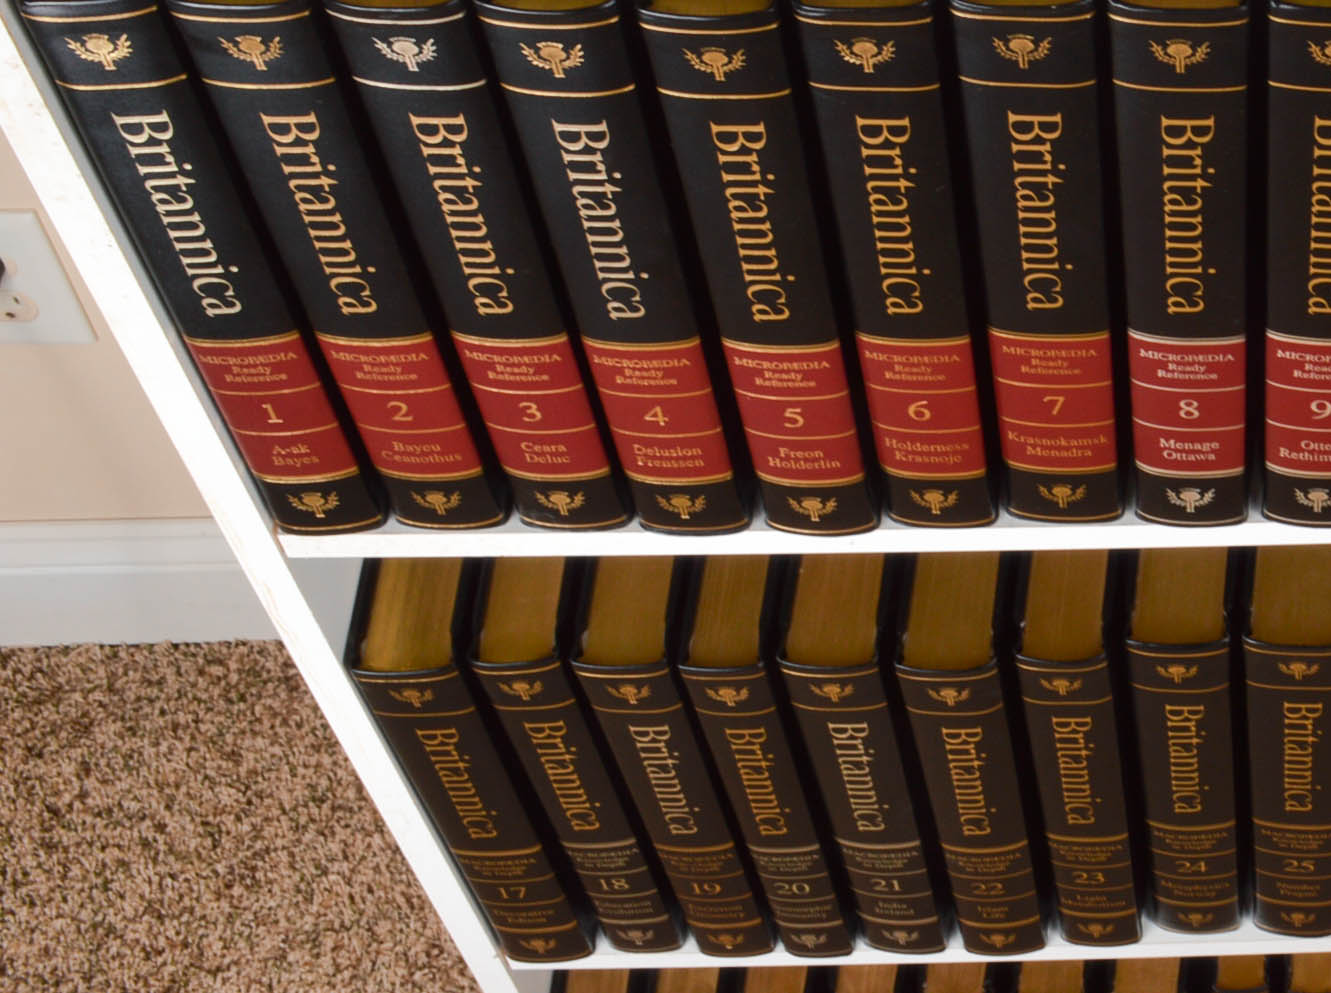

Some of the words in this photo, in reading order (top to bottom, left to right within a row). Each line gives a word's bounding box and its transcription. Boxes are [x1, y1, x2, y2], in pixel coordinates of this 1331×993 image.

[110, 109, 243, 318] Britannica
[258, 111, 378, 317] Britannica
[408, 111, 516, 317] Britannica
[855, 113, 932, 316] Britannica
[1007, 110, 1074, 311] Britannica
[1160, 114, 1216, 316] Britannica
[551, 117, 649, 321] Britannica
[709, 120, 796, 323] Britannica
[363, 364, 402, 374] Ready
[496, 365, 535, 374] Ready
[894, 364, 932, 374] Ready
[1031, 358, 1068, 368] Ready
[1168, 362, 1207, 373] Ready
[231, 366, 271, 374] Ready
[356, 371, 418, 381] Reference
[487, 371, 549, 382] Reference
[624, 369, 664, 377] Ready
[764, 371, 803, 381] Ready
[884, 371, 946, 381] Reference
[1020, 365, 1081, 375] Reference
[1157, 369, 1218, 380] Reference
[224, 373, 287, 383] Reference
[616, 375, 678, 386] Reference
[755, 377, 817, 388] Reference
[386, 401, 413, 421] 2
[518, 402, 542, 422] 3
[908, 400, 931, 421] 6
[1043, 396, 1065, 415] 7
[1179, 399, 1200, 420] 8
[262, 403, 284, 423] 1
[644, 406, 669, 426] 4
[784, 408, 804, 428] 5
[632, 444, 703, 457] Delusion
[1159, 438, 1220, 451] Menage
[778, 447, 824, 458] Freon
[1162, 450, 1217, 461] Ottawa
[1165, 704, 1210, 814] Britannica
[1284, 701, 1323, 812] Britannica
[523, 720, 601, 831] Britannica
[827, 721, 889, 832] Britannica
[1052, 715, 1103, 825] Britannica
[415, 727, 498, 840] Britannica
[629, 725, 700, 835] Britannica
[725, 727, 791, 836] Britannica
[941, 727, 997, 836] Britannica
[1175, 860, 1207, 873] 24
[1282, 860, 1315, 873] 25
[600, 878, 630, 891] 18
[870, 878, 900, 891] 21
[1072, 872, 1105, 884] 23
[497, 886, 526, 899] 17
[691, 882, 723, 895] 19
[773, 882, 810, 895] 20
[972, 882, 1004, 895] 22
